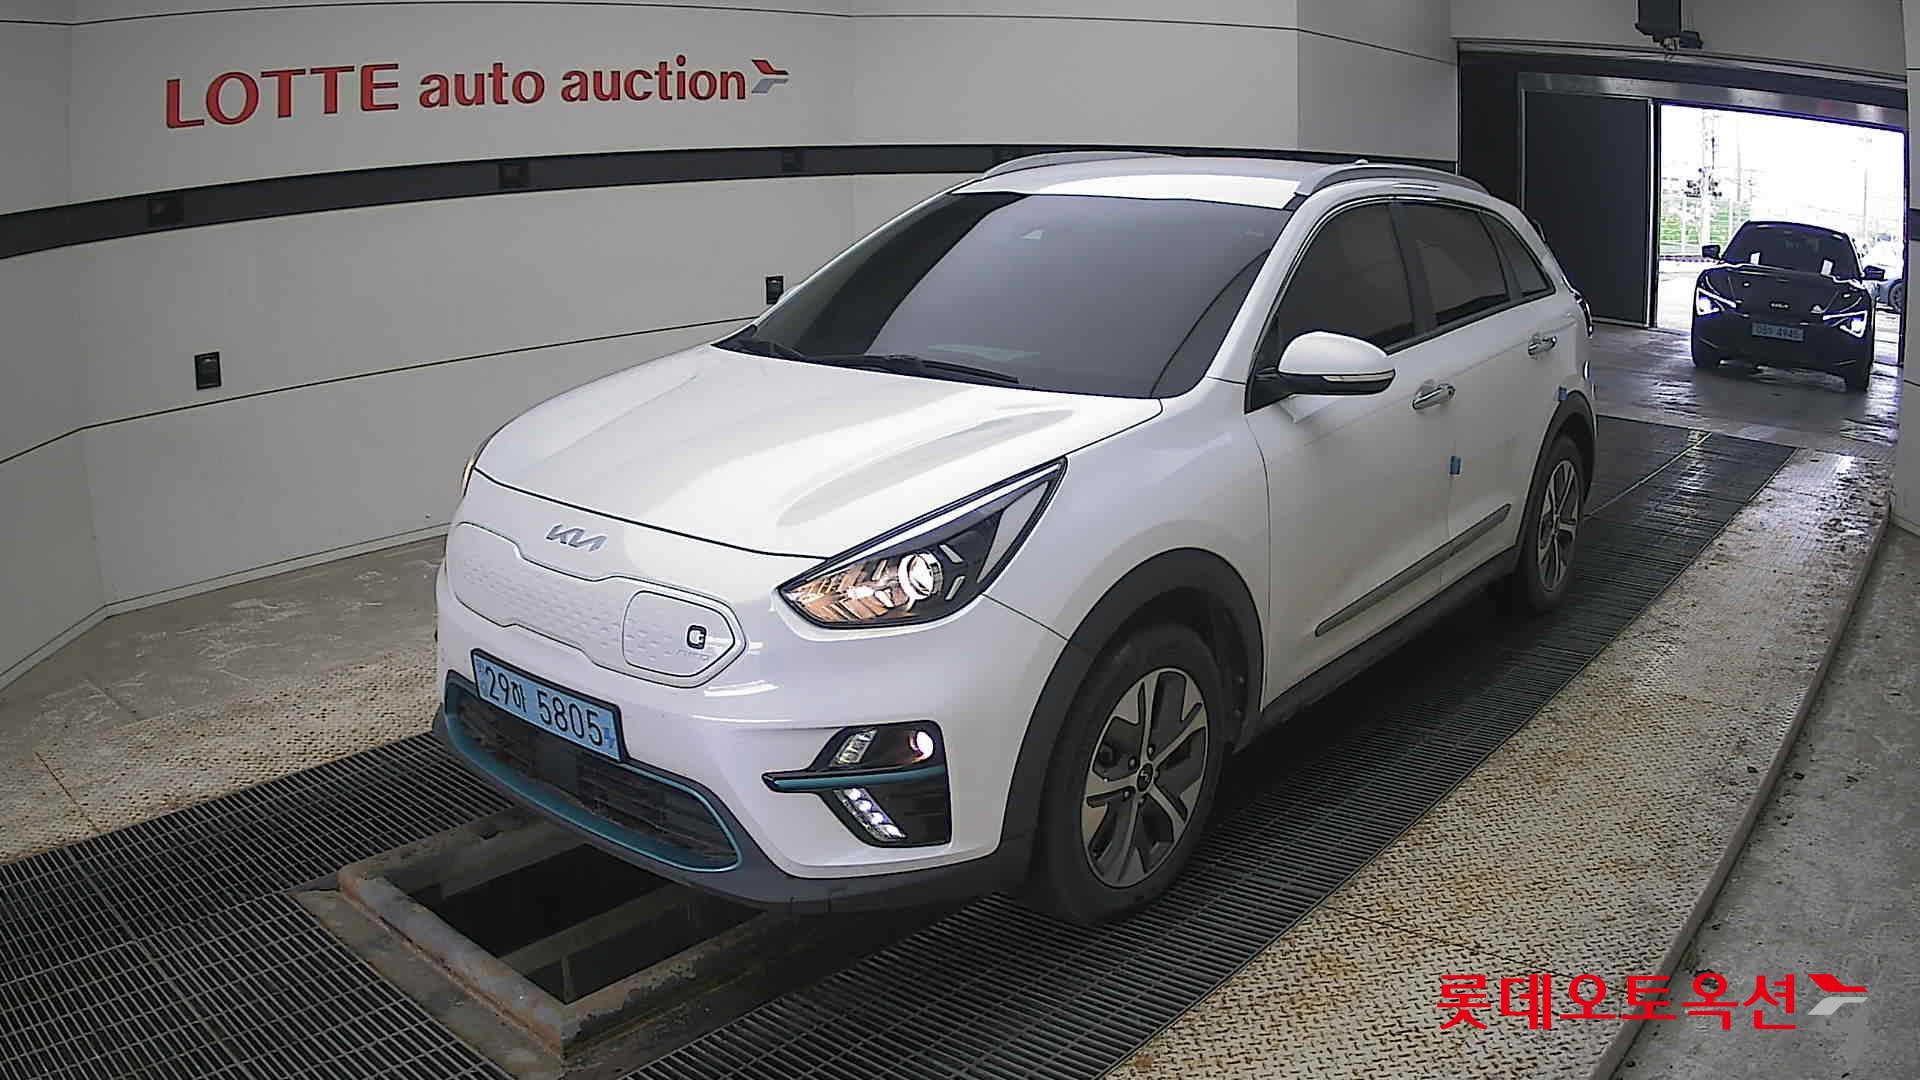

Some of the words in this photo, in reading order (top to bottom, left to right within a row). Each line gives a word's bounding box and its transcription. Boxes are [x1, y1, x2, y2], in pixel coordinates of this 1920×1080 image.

[166, 64, 399, 129] LOTTE
[419, 62, 545, 108] auto
[561, 54, 746, 102] auction
[536, 689, 603, 747] 5805
